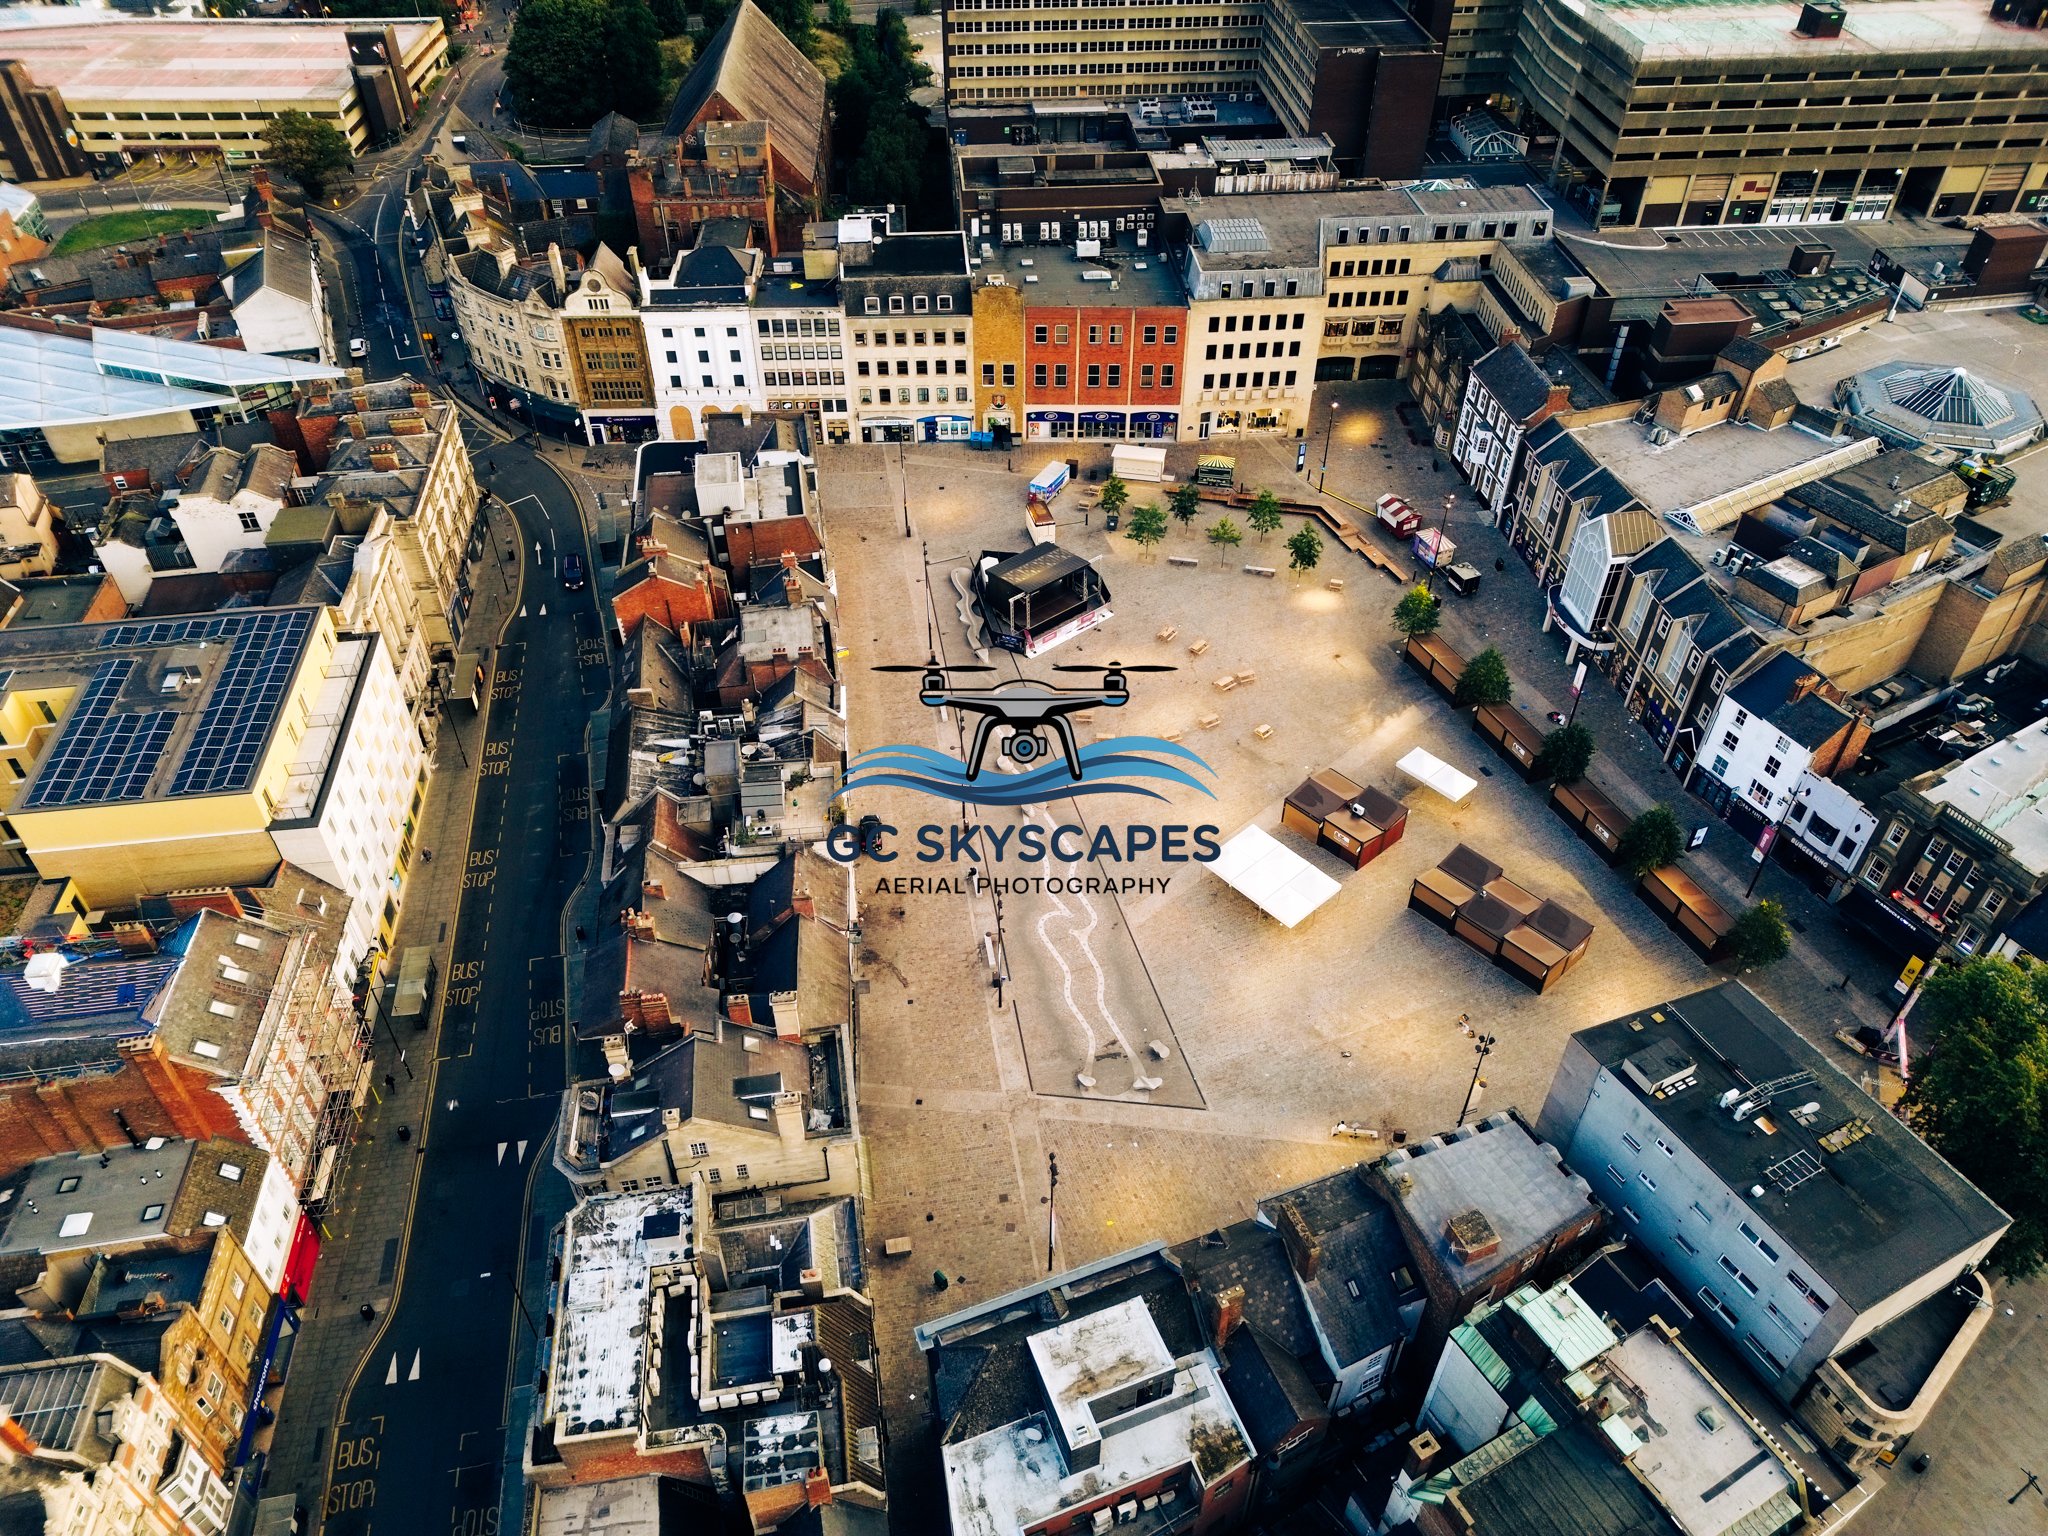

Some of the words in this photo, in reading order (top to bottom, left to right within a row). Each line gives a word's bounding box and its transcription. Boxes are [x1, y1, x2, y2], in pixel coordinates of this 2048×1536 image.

[579, 637, 605, 651] STOP
[583, 652, 604, 666] BUS
[495, 670, 518, 683] BUS
[491, 685, 520, 700] STOP
[486, 741, 509, 756] BUS
[479, 760, 510, 777] STOP
[563, 806, 588, 822] BUS
[469, 849, 494, 867] BUS
[1790, 837, 1814, 858] BURGER
[1812, 854, 1829, 868] KING
[463, 871, 494, 889] STOP
[452, 961, 479, 981] BUS
[445, 986, 479, 1007] STOP
[530, 999, 565, 1021] STOP
[533, 1025, 561, 1046] BUS
[253, 1358, 270, 1411] shoezone
[337, 1437, 375, 1470] BUS
[328, 1479, 374, 1514] STOP
[452, 1506, 499, 1536] STOP
